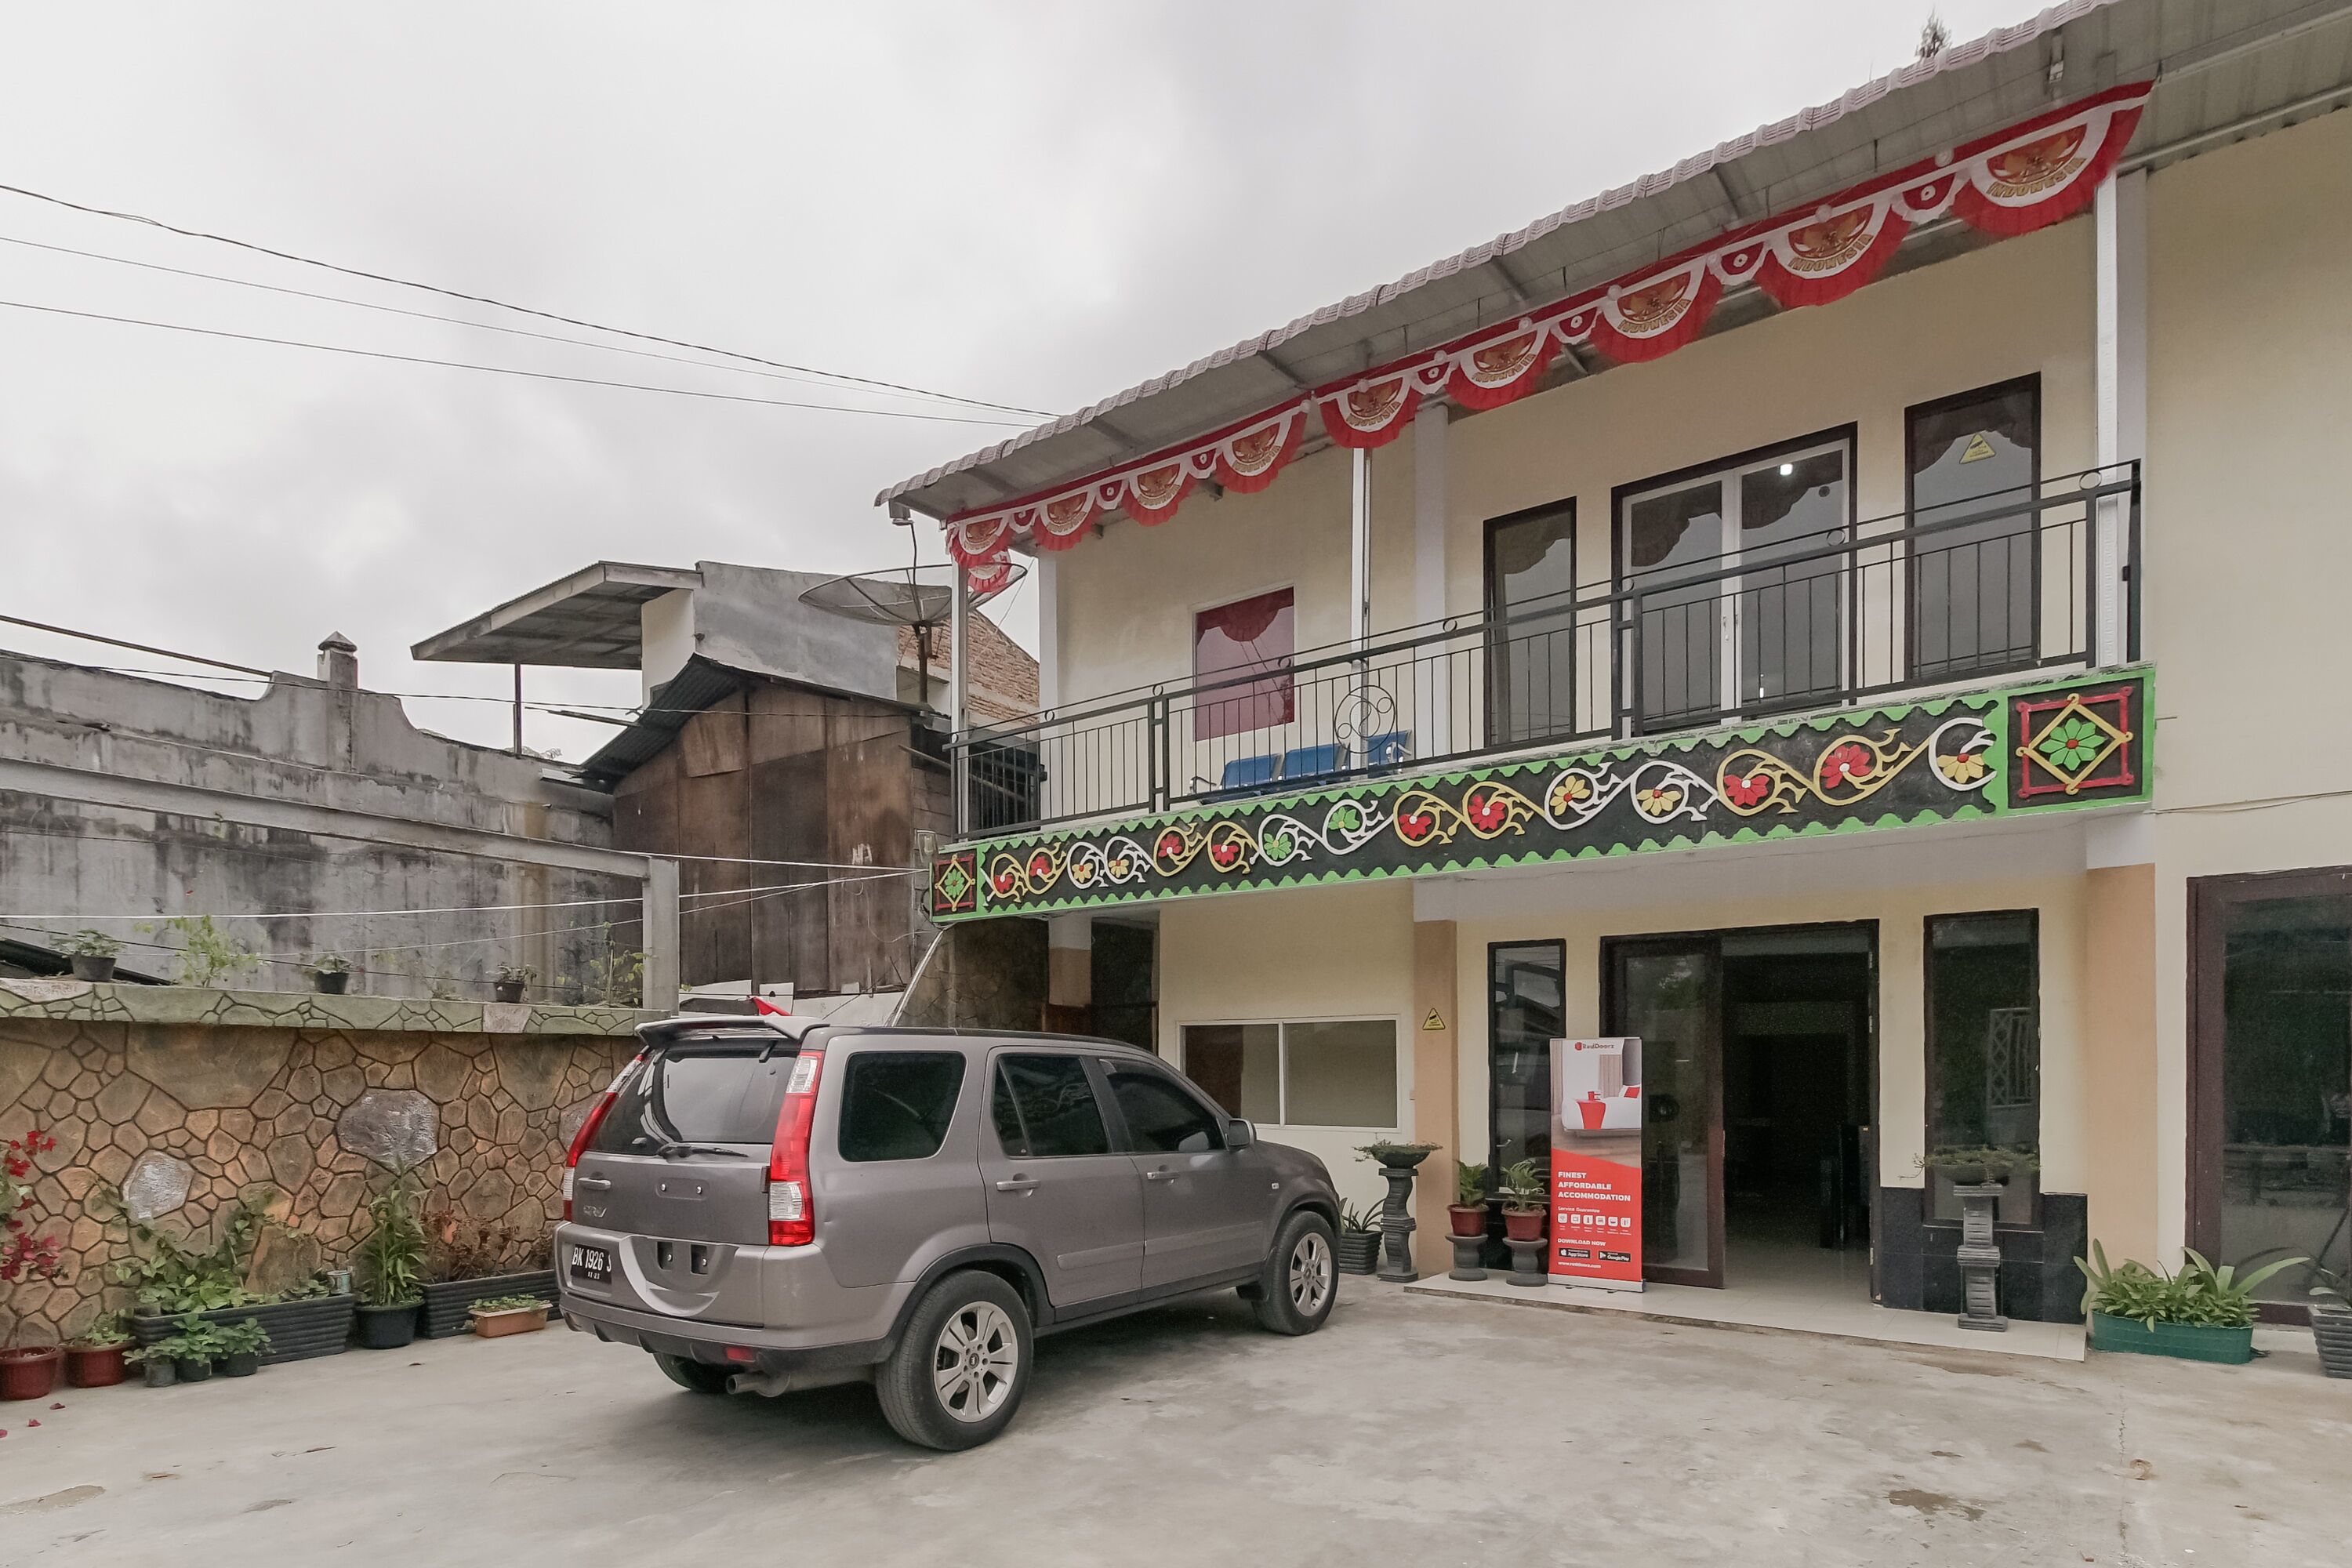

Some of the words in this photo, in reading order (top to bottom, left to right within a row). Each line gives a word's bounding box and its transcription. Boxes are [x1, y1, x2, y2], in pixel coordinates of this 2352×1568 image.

[1986, 158, 2086, 198] INDONESIA
[1788, 234, 1874, 271] INDONESIA
[1617, 299, 1691, 333] INDONESIA
[1558, 1181, 1612, 1190] AFFORDABLE
[1558, 1192, 1631, 1201] ACCOMMODATION
[572, 1247, 584, 1267] BK
[585, 1249, 604, 1271] 1926
